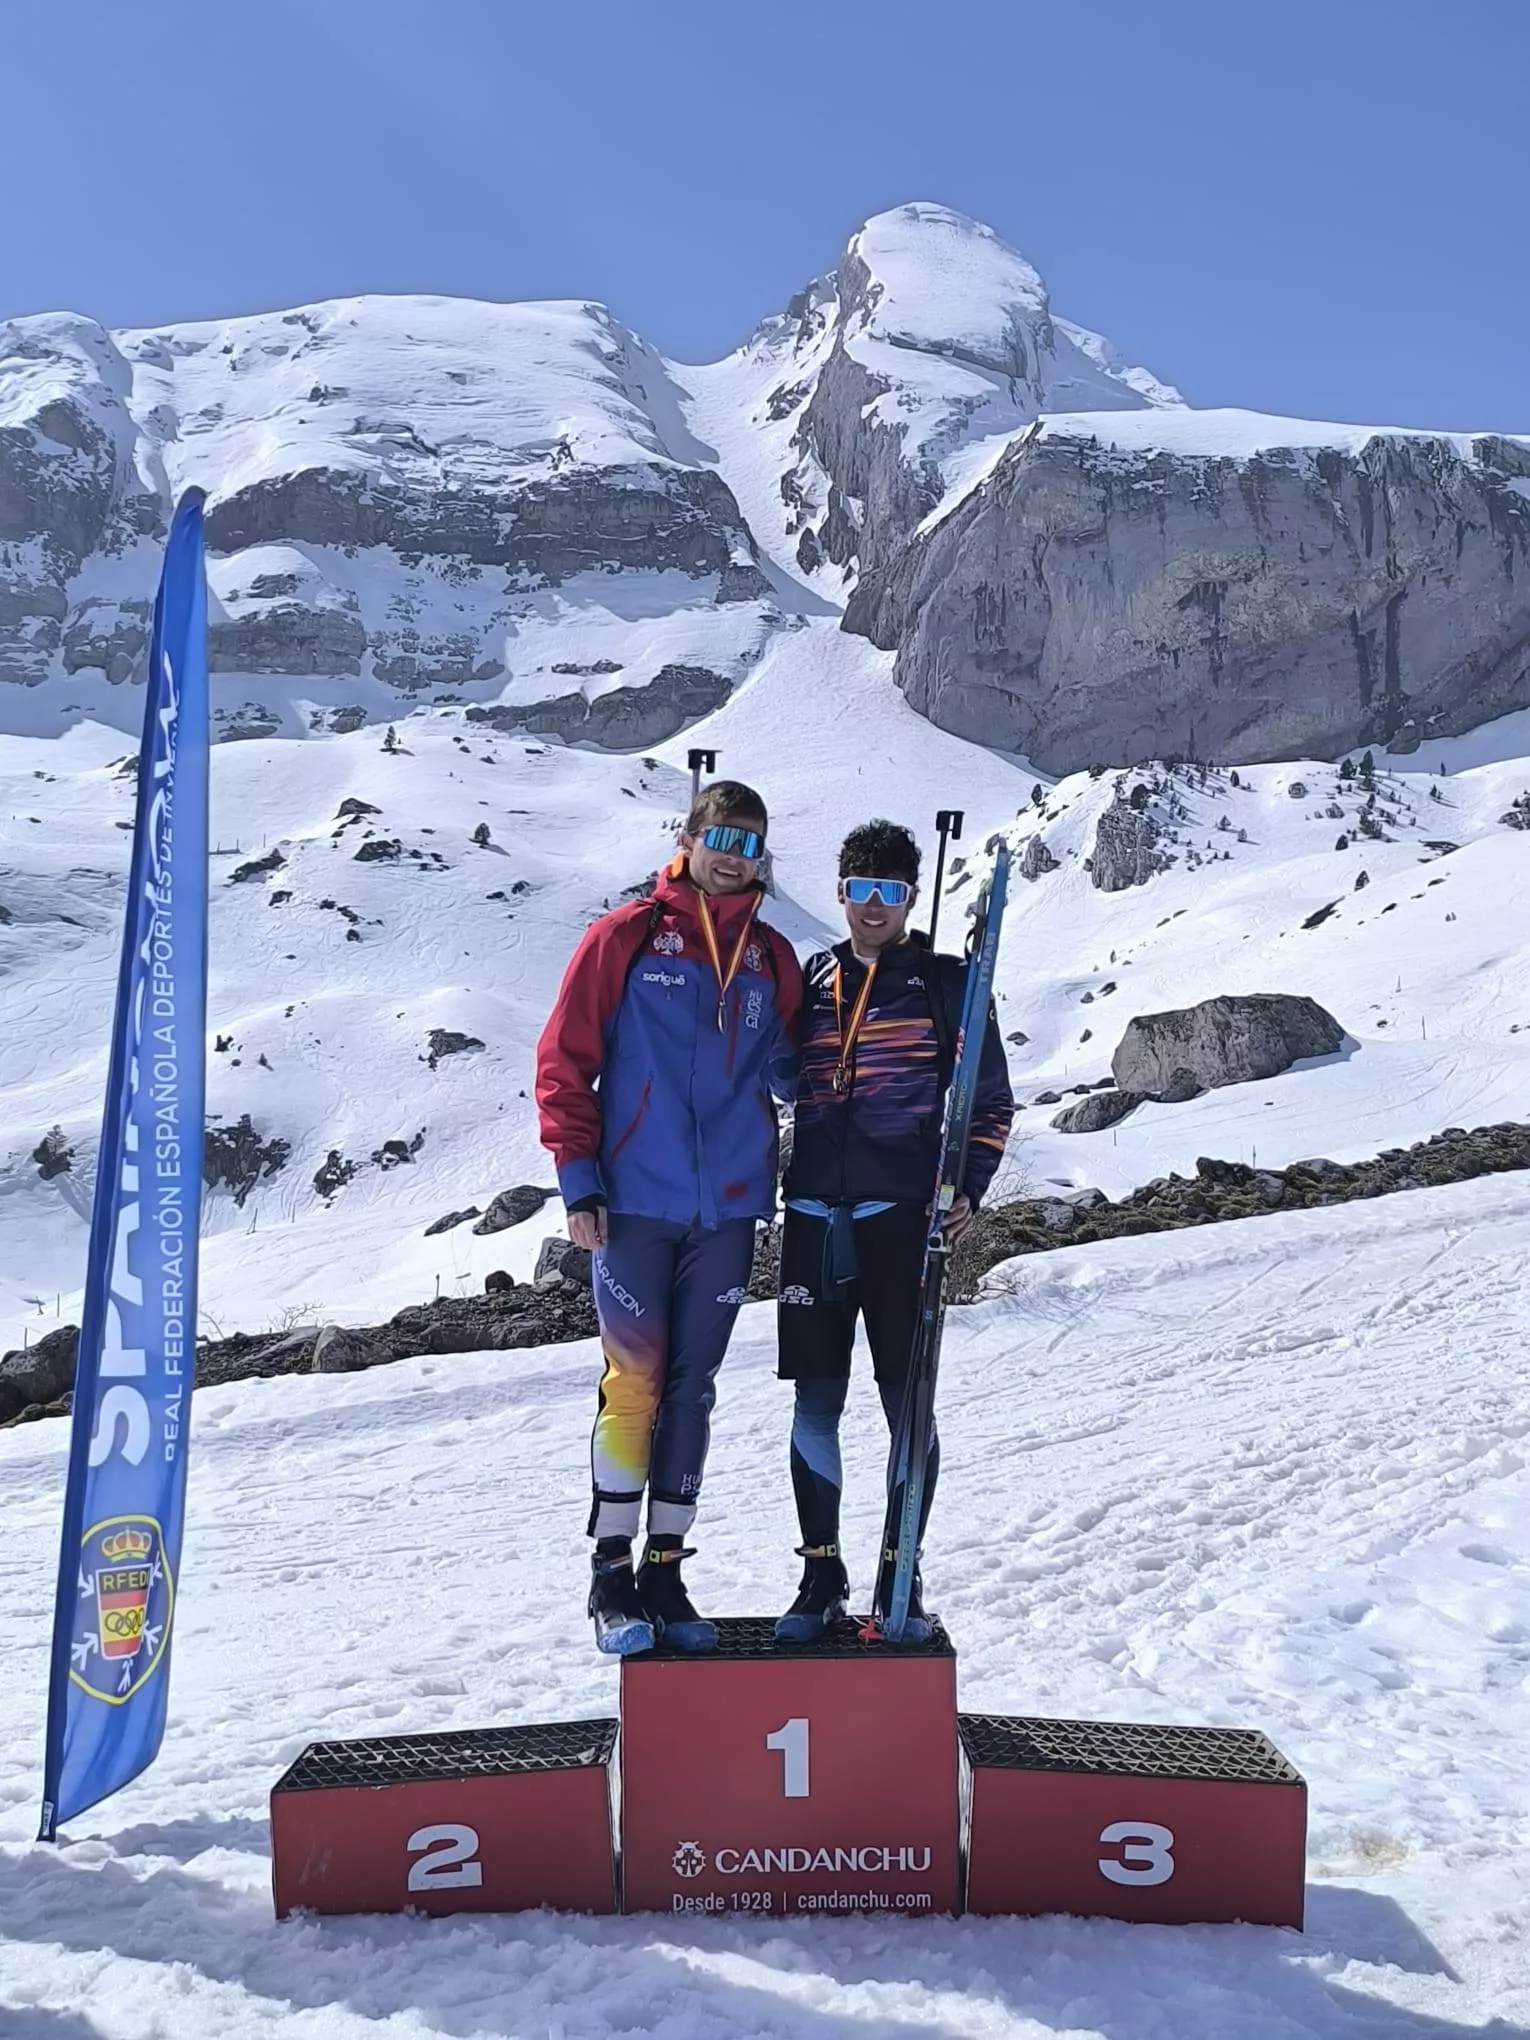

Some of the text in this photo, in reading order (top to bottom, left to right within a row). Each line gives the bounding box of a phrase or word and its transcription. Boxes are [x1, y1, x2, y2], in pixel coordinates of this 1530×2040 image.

[152, 870, 176, 1017] DEPORTES
[149, 1024, 181, 1177] ESPAÑOLA
[152, 1187, 184, 1376] FEDERACIÓN
[596, 1258, 645, 1317] ARAGON
[766, 1718, 809, 1797] 1
[407, 1823, 482, 1891] 2
[715, 1847, 931, 1873] CANDANCHU
[1098, 1821, 1174, 1886] 3
[672, 1890, 932, 1911] Desde 1928 candanchu.com
